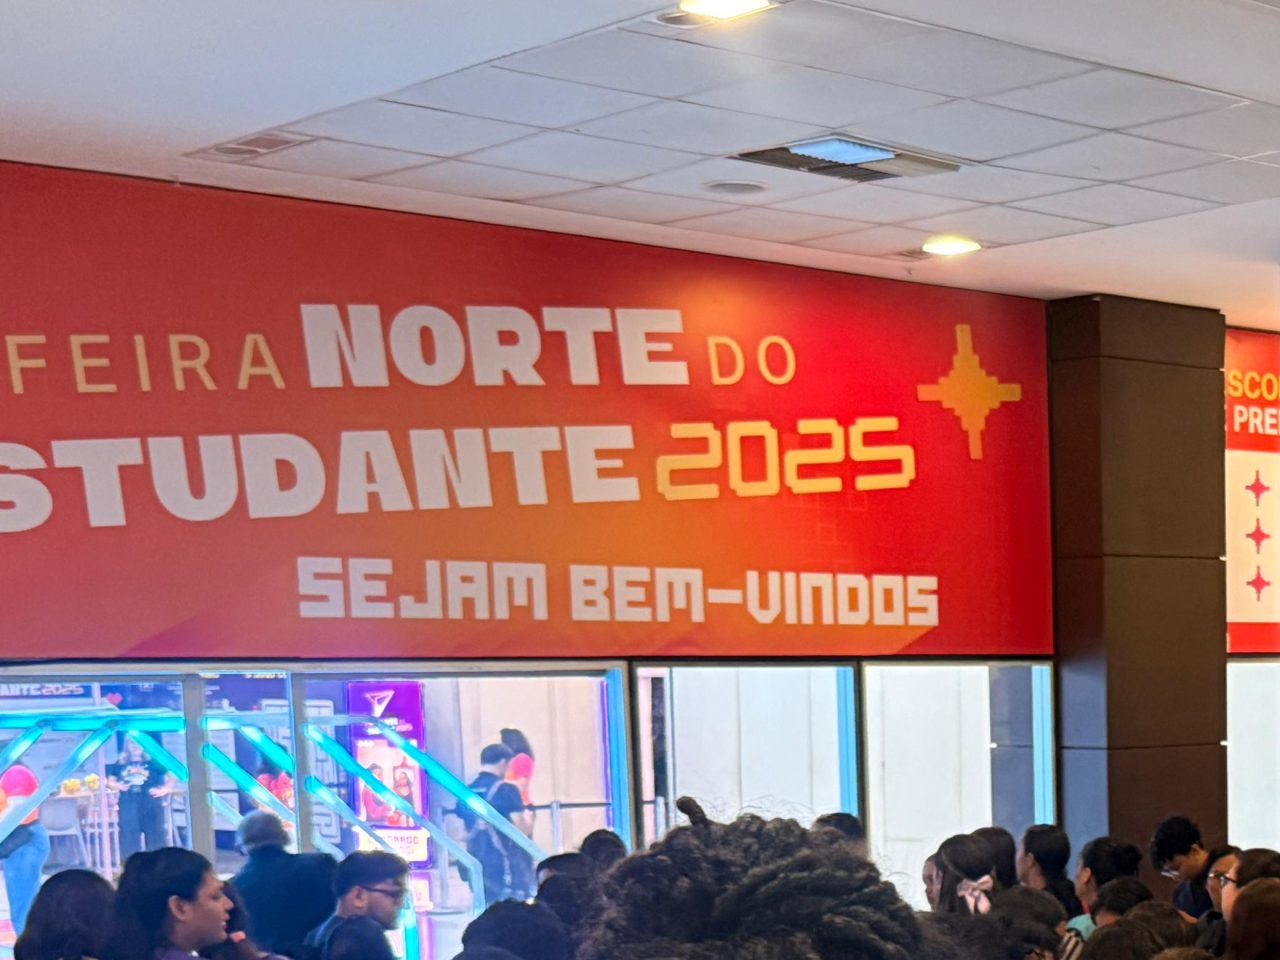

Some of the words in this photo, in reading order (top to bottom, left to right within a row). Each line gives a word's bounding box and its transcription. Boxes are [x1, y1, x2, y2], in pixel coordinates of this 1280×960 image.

[5, 333, 287, 395] FEIRA
[299, 303, 690, 388] NORTE
[707, 334, 797, 386] DO
[0, 424, 641, 534] STUDANTE
[656, 416, 917, 502] 2025
[297, 556, 549, 621] SEJAM
[569, 563, 939, 627] BEM-VINDOS
